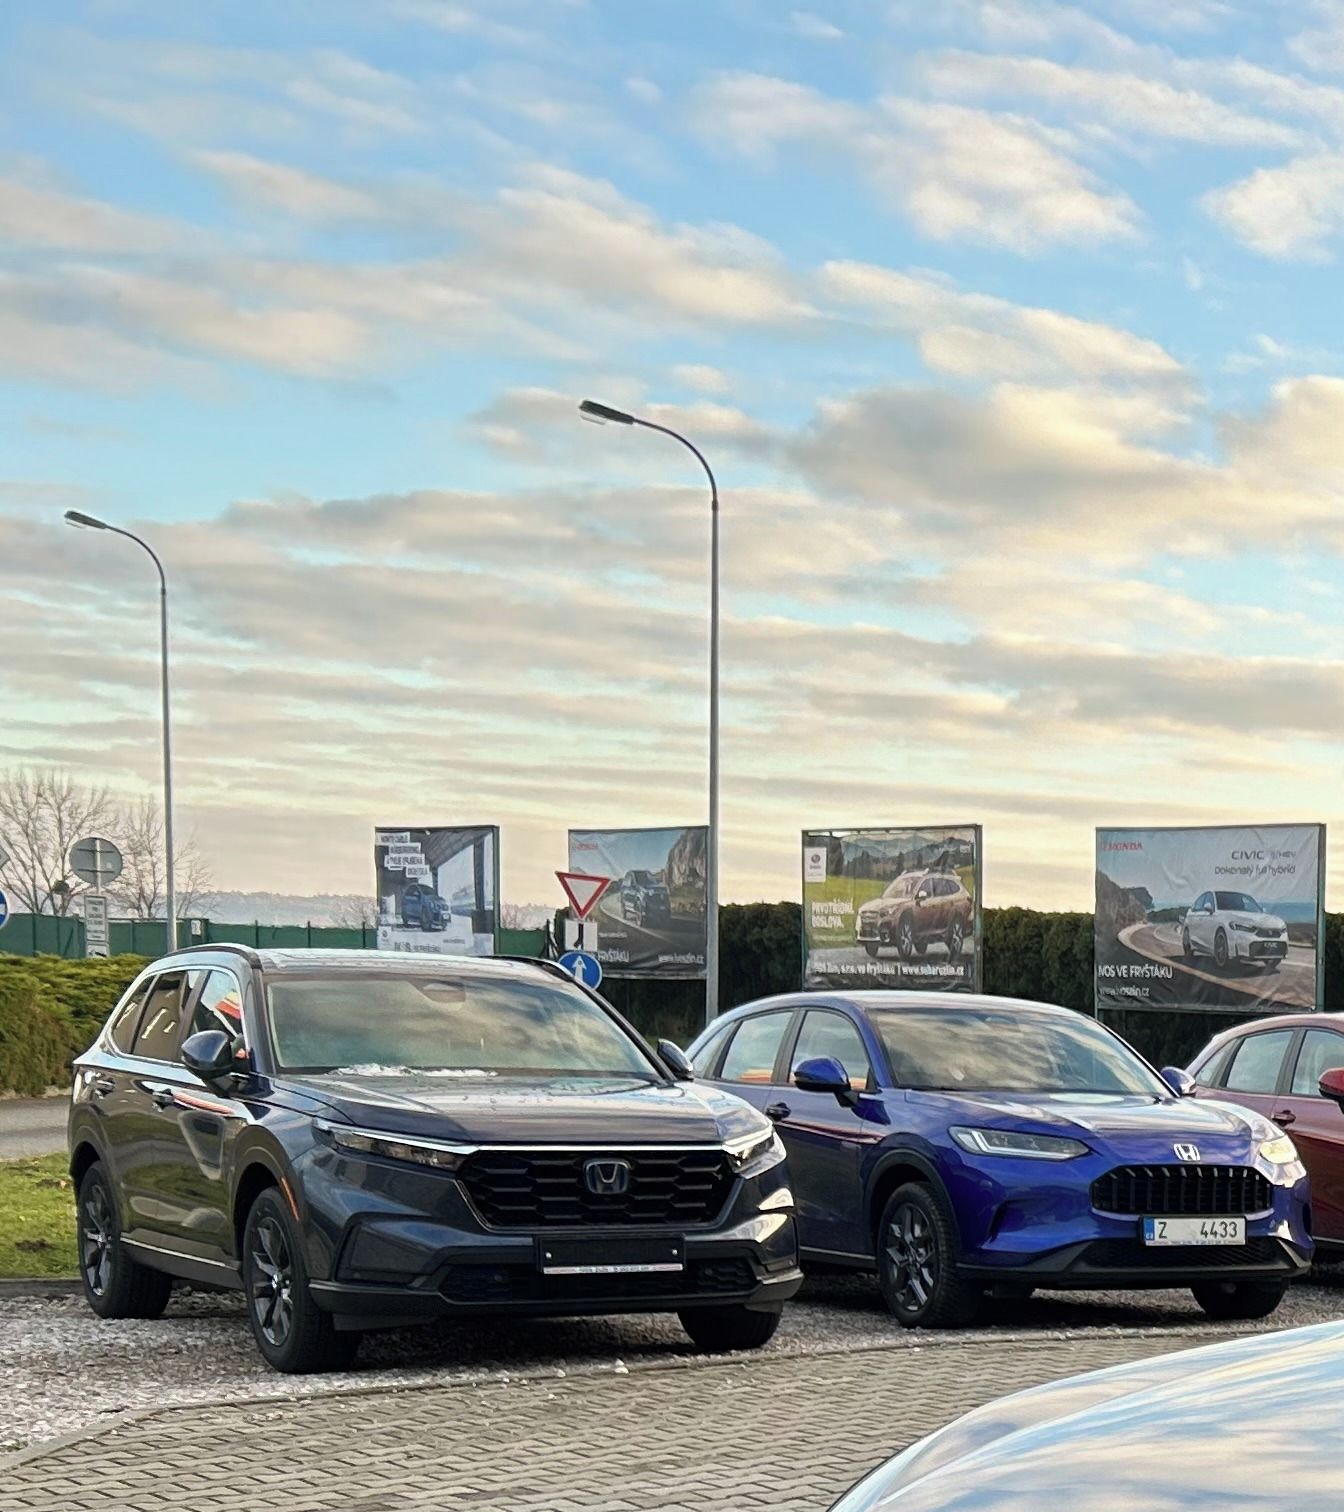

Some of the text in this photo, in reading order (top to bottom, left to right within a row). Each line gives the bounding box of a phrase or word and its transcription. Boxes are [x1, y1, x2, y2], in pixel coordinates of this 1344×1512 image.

[1232, 850, 1265, 860] CIVIC
[1268, 863, 1296, 877] hybrid
[1117, 965, 1129, 977] VE
[1130, 962, 1173, 978] FRYŠTÁKU
[1158, 1221, 1238, 1239] Z 4433
